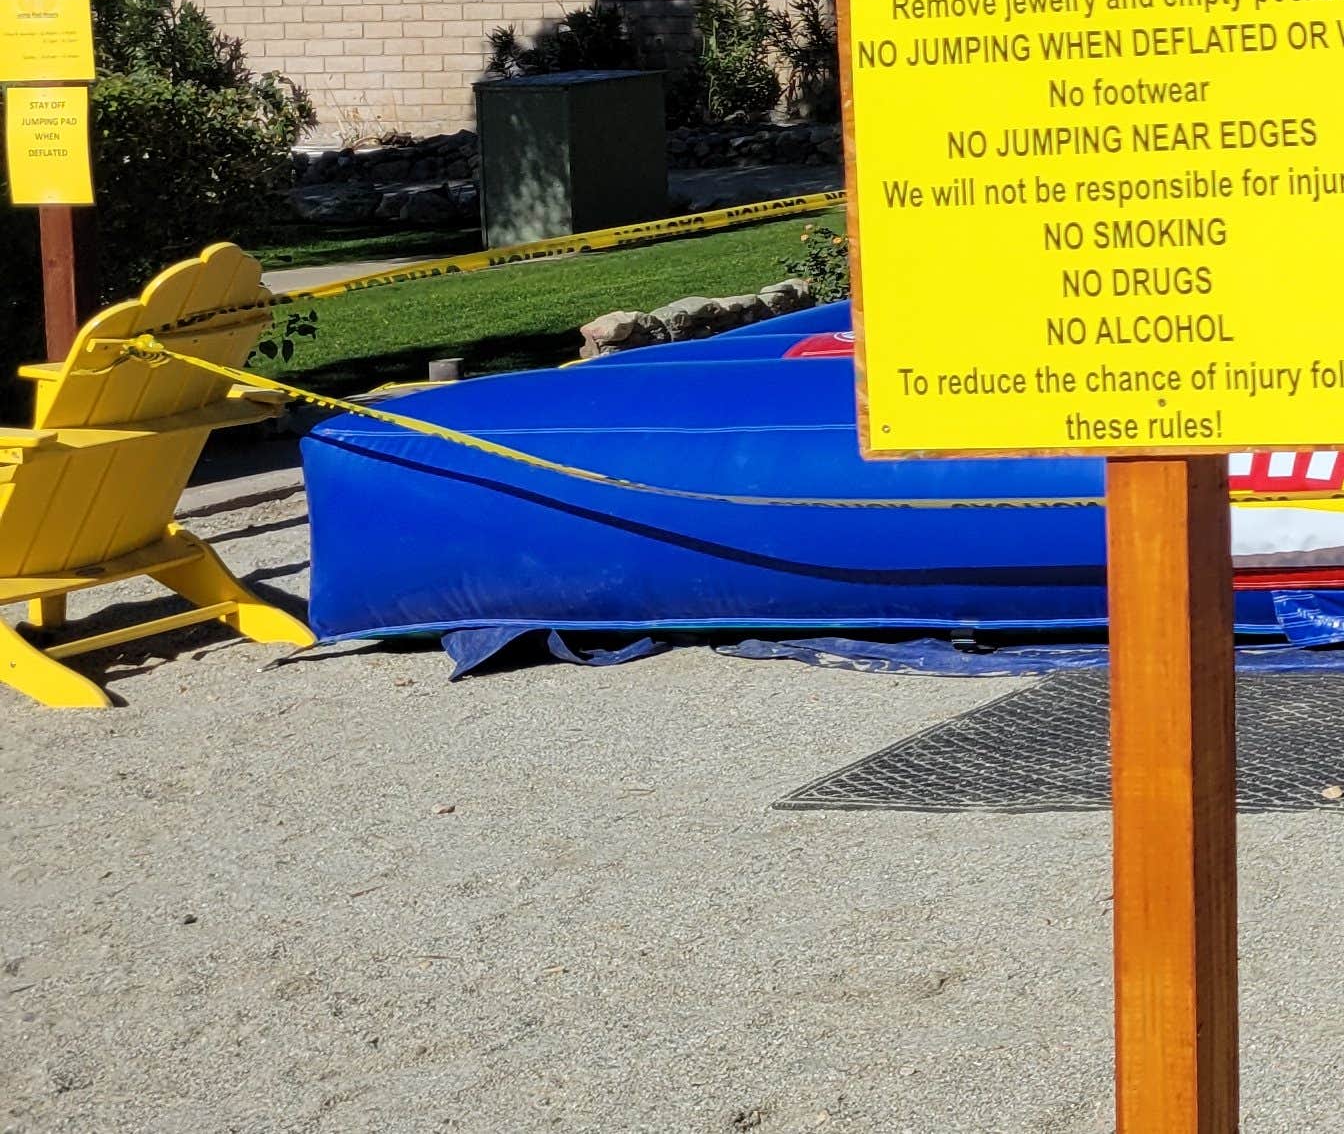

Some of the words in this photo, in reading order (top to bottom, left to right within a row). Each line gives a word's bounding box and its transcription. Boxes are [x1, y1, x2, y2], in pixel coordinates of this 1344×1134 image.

[859, 40, 897, 68] NO
[906, 34, 1030, 66] JUMPING
[1039, 30, 1122, 60] WHEN
[1132, 23, 1277, 56] DEFLATED
[1288, 21, 1329, 50] OR
[1049, 80, 1084, 107] No
[1093, 78, 1210, 105] footwear
[948, 131, 987, 159] NO
[996, 125, 1121, 157] JUMPING
[1133, 122, 1211, 152] NEAR
[1220, 118, 1317, 149] EDGES
[883, 181, 923, 208] We
[931, 178, 974, 206] will
[985, 178, 1027, 204] not
[1036, 176, 1066, 203] be
[1076, 170, 1232, 208] responsible
[1242, 169, 1279, 196] for
[1044, 222, 1083, 250] NO
[1094, 218, 1226, 249] SMOKING
[1063, 269, 1102, 297] NO
[1113, 266, 1212, 296] DRUGS
[1047, 317, 1086, 345] NO
[1096, 314, 1234, 344] ALCOHOL
[897, 369, 928, 395] To
[938, 367, 1026, 394] reduce
[1035, 366, 1076, 393] the
[1086, 365, 1181, 392] chance
[1191, 362, 1216, 390] of
[1226, 362, 1301, 397] injury
[1066, 413, 1138, 440] these
[1149, 410, 1221, 438] rules!
